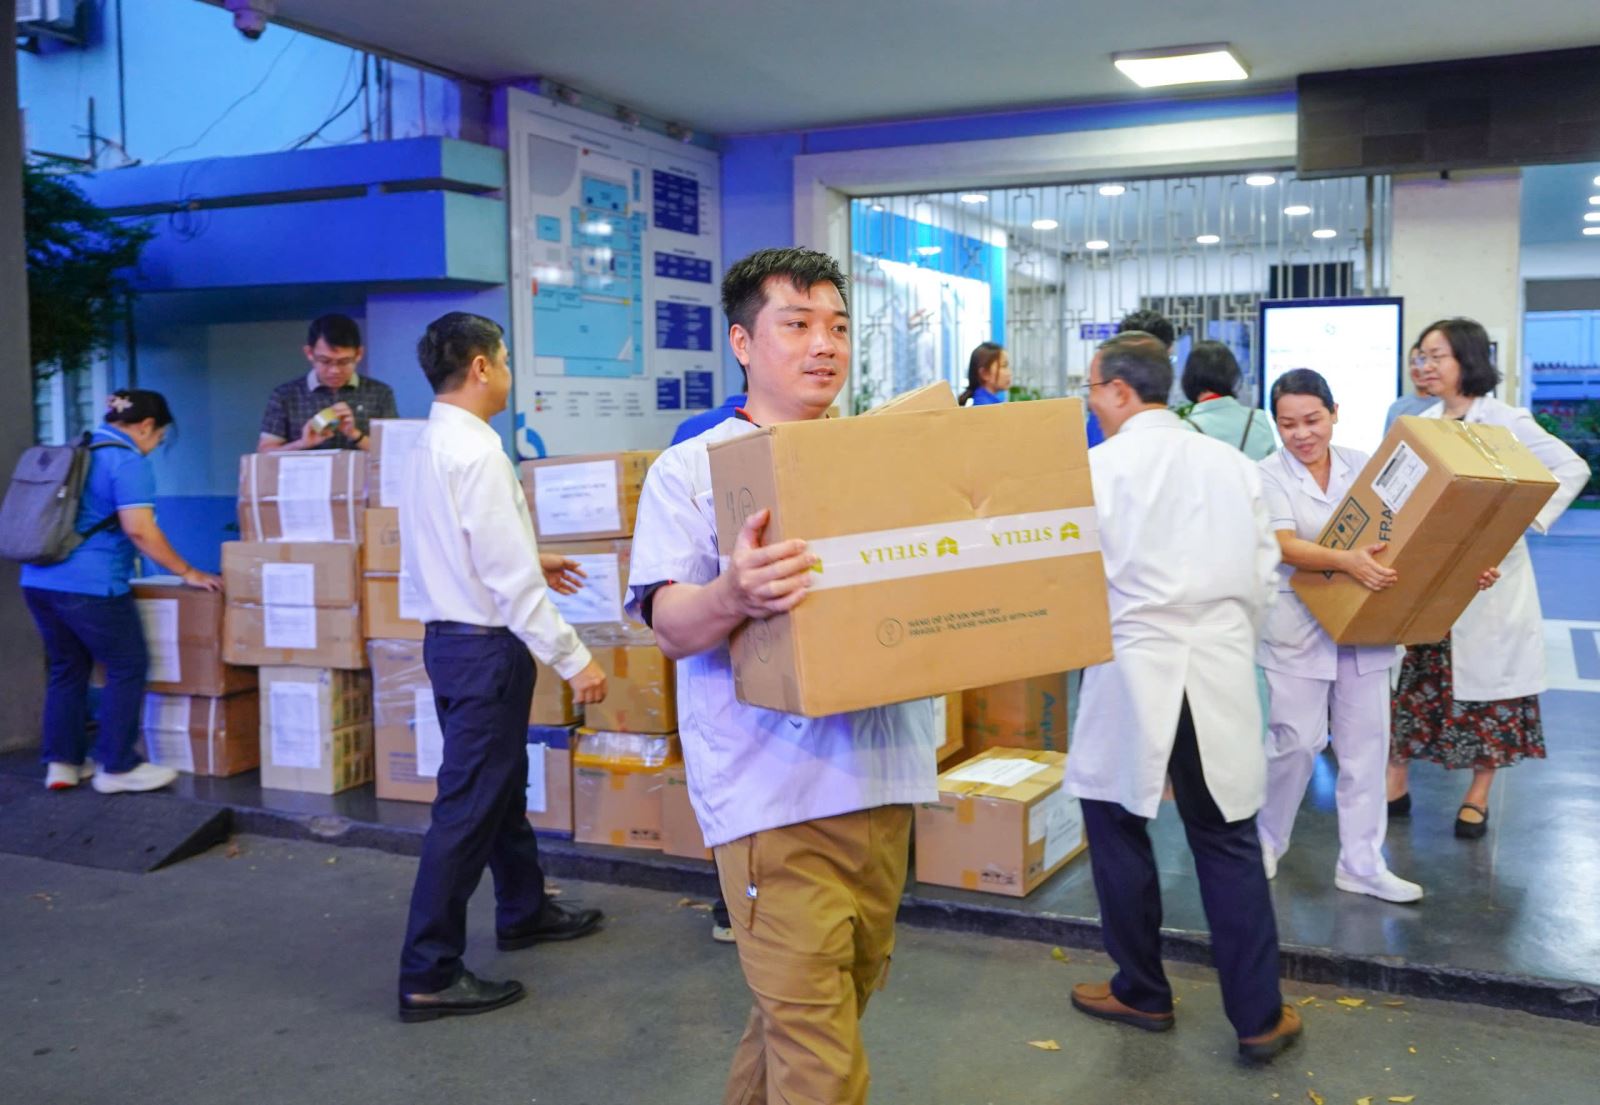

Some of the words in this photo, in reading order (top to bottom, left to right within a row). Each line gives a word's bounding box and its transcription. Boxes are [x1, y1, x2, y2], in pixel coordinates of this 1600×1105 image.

[1379, 501, 1392, 541] FRA
[991, 527, 1052, 547] STELLA
[859, 542, 927, 564] STELLA
